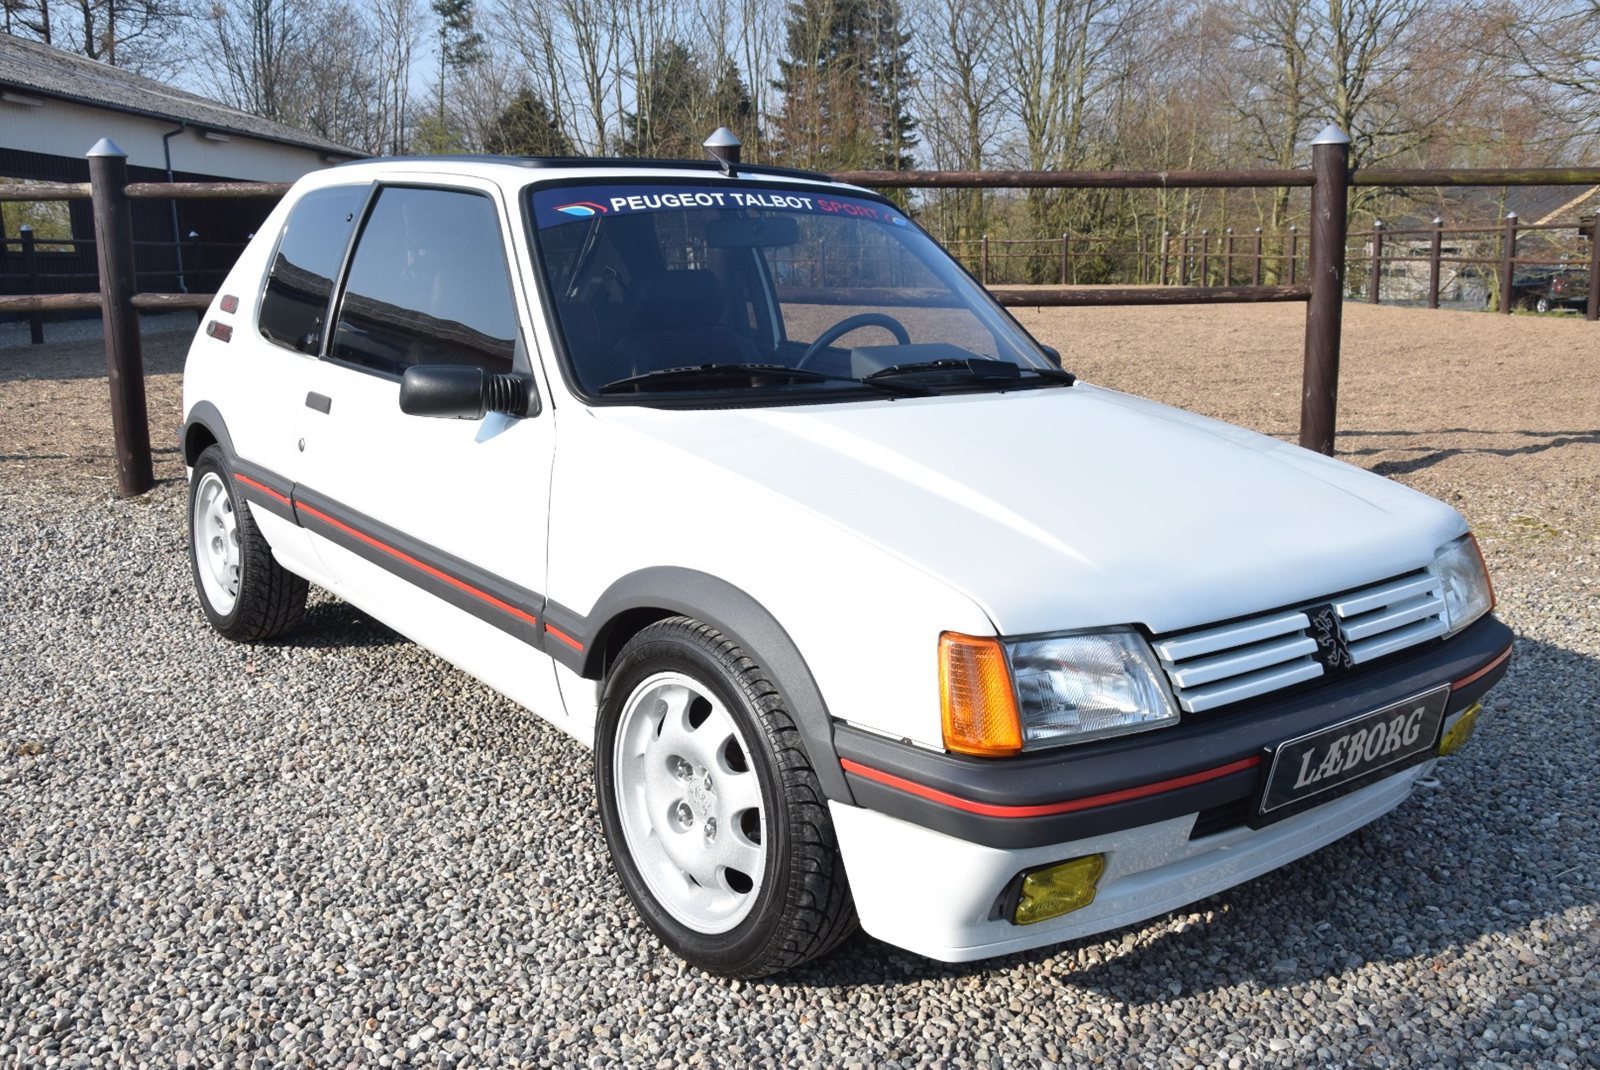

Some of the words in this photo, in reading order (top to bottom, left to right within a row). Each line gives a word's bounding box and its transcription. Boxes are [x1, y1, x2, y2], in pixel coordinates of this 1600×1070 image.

[610, 192, 724, 212] PEUGEOT
[730, 193, 813, 210] TALBOT
[817, 199, 878, 220] SPORT
[1293, 706, 1425, 789] LÆBORG
